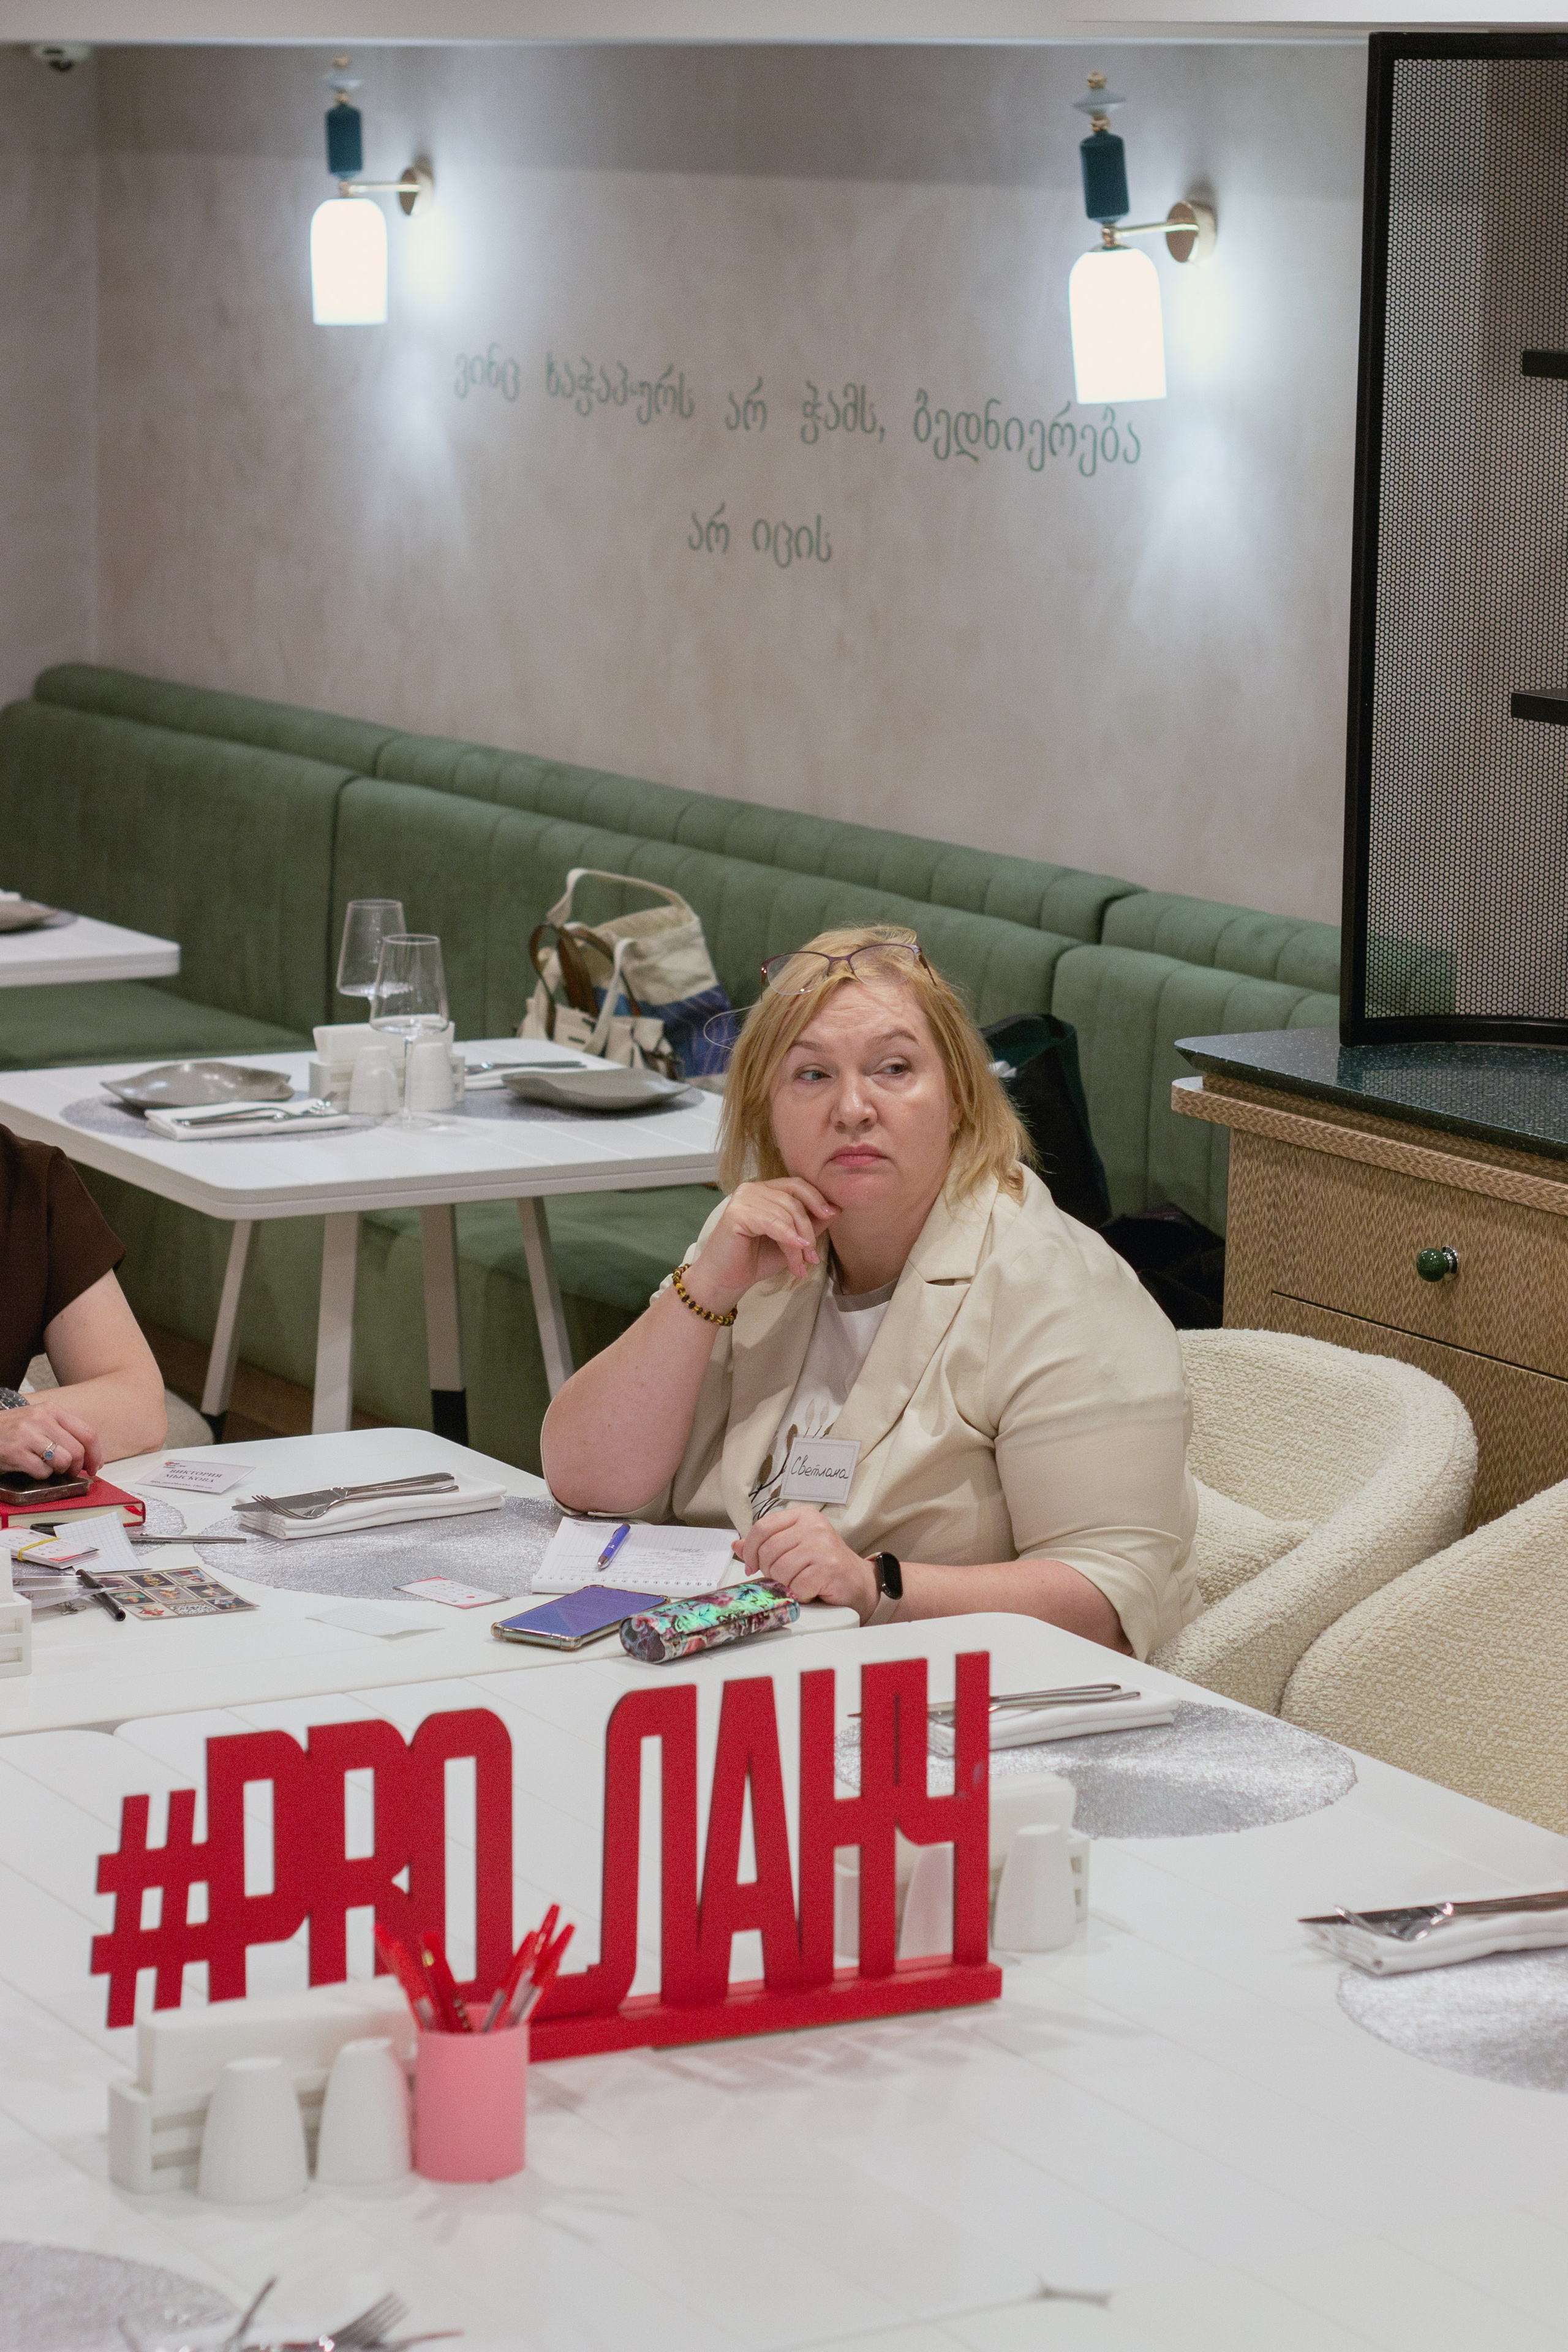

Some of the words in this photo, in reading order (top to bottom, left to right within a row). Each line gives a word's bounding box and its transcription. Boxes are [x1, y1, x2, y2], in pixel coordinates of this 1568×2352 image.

[454, 342, 521, 402] ვინც
[725, 375, 768, 432] არ
[913, 387, 1141, 478] ბედნიერება
[688, 502, 730, 554] არ
[752, 513, 832, 569] იცის
[791, 1455, 849, 1479] Светлана
